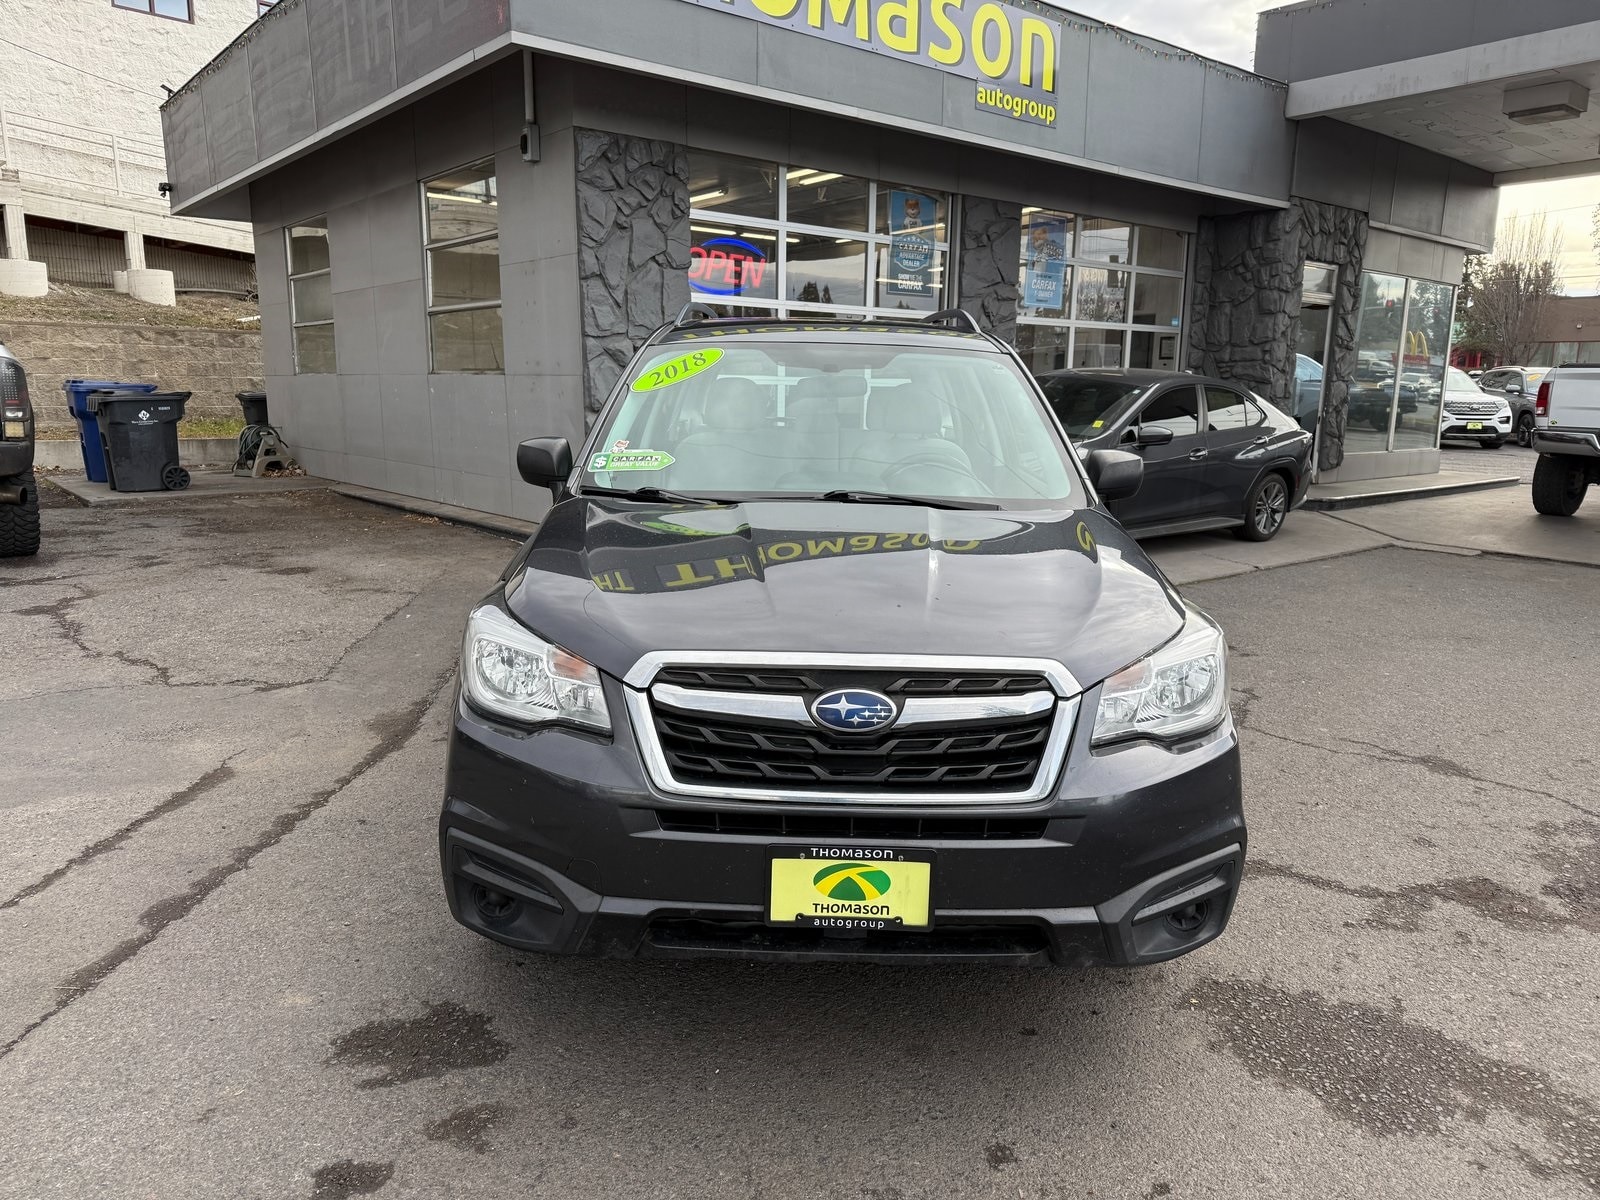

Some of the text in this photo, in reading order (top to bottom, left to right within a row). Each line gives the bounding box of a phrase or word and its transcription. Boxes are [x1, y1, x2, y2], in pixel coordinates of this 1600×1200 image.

[976, 86, 1056, 125] autogroup
[688, 246, 766, 289] OPEN
[902, 259, 920, 268] DEALER
[1031, 279, 1057, 291] CARFAX
[650, 352, 707, 387] 2018
[810, 847, 894, 859] THOMason
[812, 902, 890, 915] THOMason
[813, 917, 885, 929] autogroup
